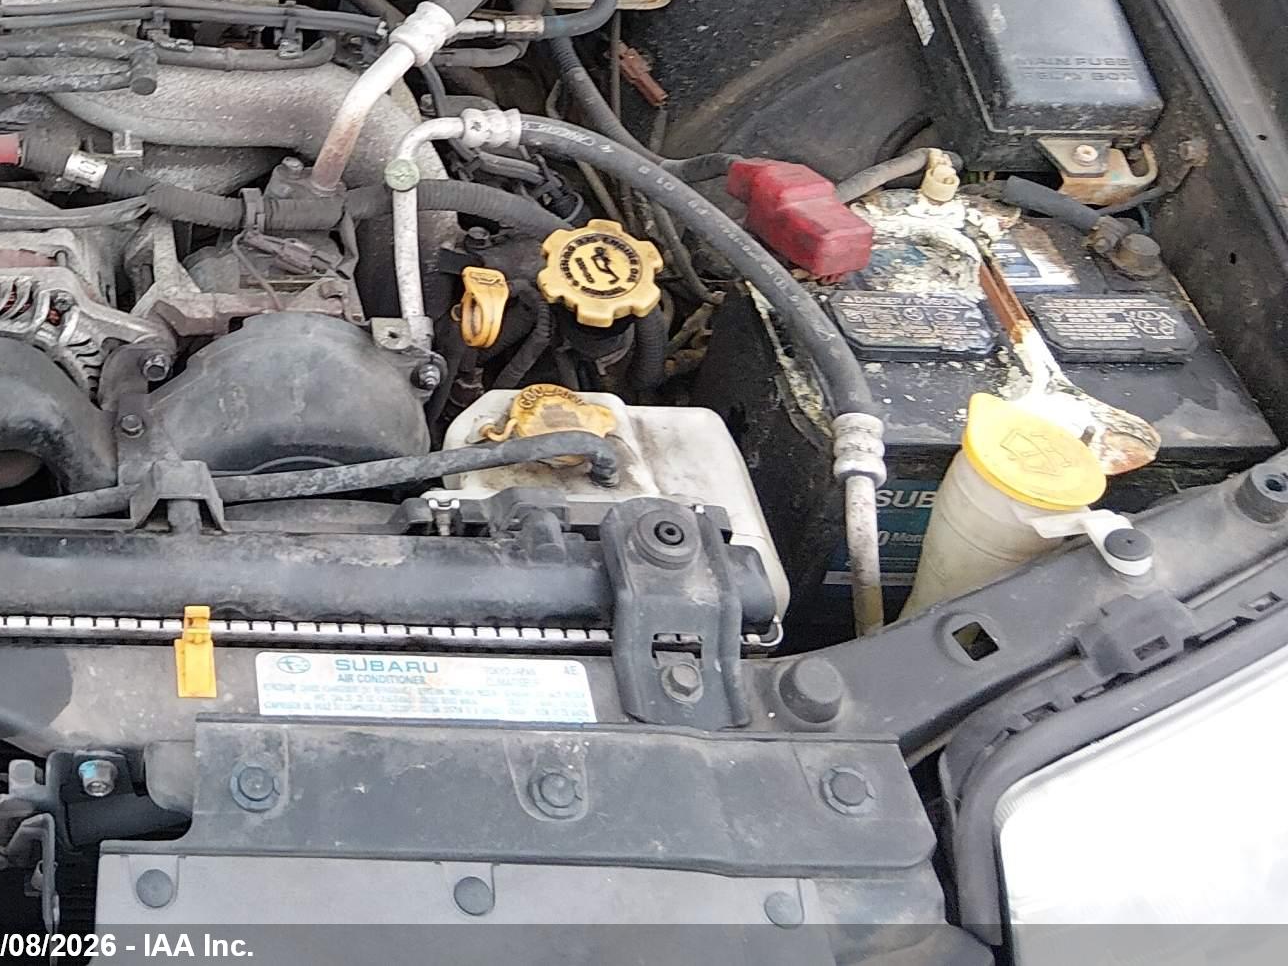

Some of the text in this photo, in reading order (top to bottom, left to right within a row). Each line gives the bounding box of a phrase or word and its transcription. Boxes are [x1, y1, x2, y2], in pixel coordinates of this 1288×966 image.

[1075, 57, 1130, 66] FUSE
[1089, 72, 1138, 81] BOX
[335, 658, 439, 674] SUBARU
[337, 674, 426, 684] AIR CONDITIONER
